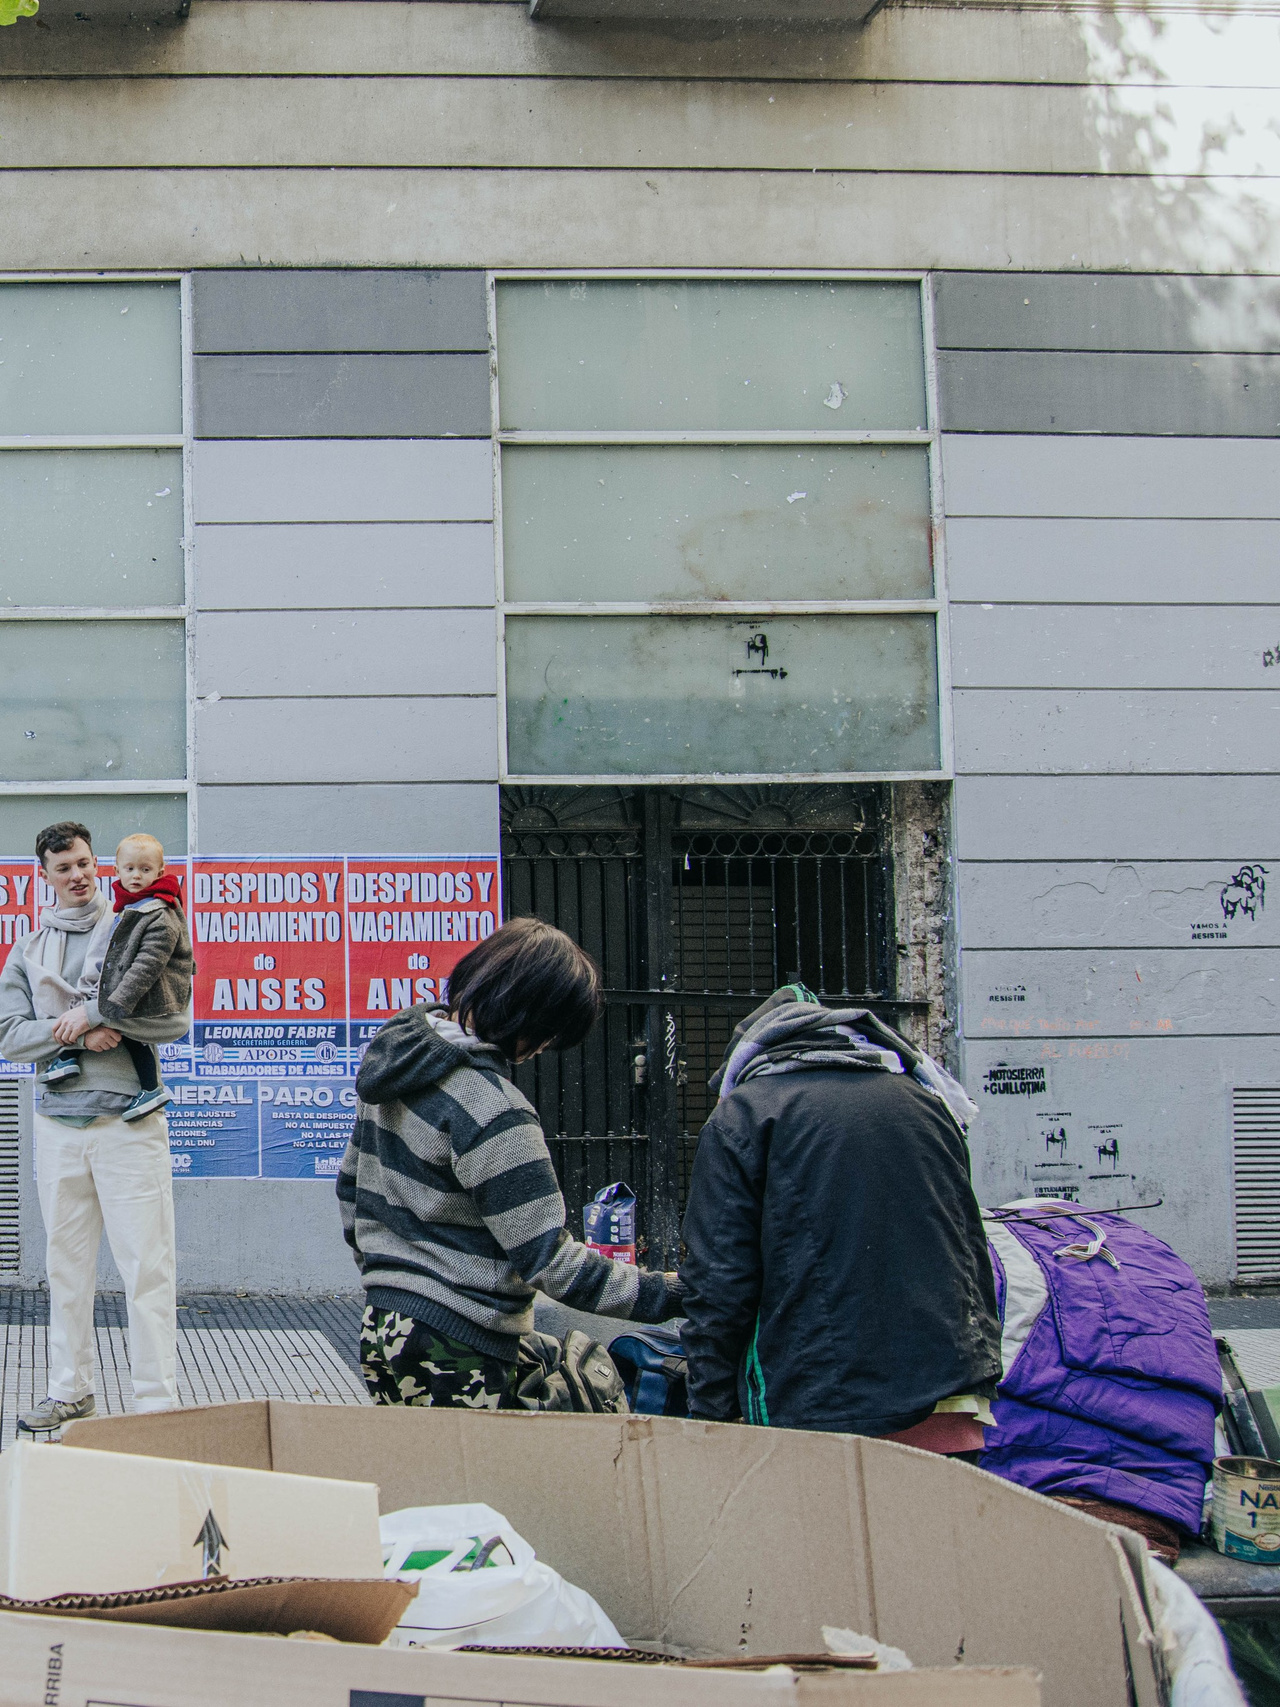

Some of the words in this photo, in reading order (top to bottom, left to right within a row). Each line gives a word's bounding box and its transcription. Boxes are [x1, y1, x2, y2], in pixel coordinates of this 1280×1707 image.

[13, 876, 30, 905] Y
[195, 873, 318, 904] DESPIDOS
[323, 873, 340, 902] Y
[348, 872, 472, 903] DESPIDOS
[476, 873, 494, 902] Y
[195, 911, 340, 943] VACIAMIENTO
[349, 911, 494, 942] VACIAMIENTO
[254, 954, 274, 970] de
[408, 954, 429, 969] de
[212, 978, 324, 1010] ANSES
[204, 1027, 284, 1038] LEONARDO
[288, 1026, 336, 1038] FABRE
[244, 1049, 296, 1060] APOPS
[199, 1065, 286, 1075] TRABAJADORES
[289, 1065, 304, 1075] DE
[306, 1065, 343, 1075] ANSES
[164, 1086, 253, 1104] NERAL
[259, 1087, 333, 1107] PARO
[1247, 1511, 1257, 1528] 1
